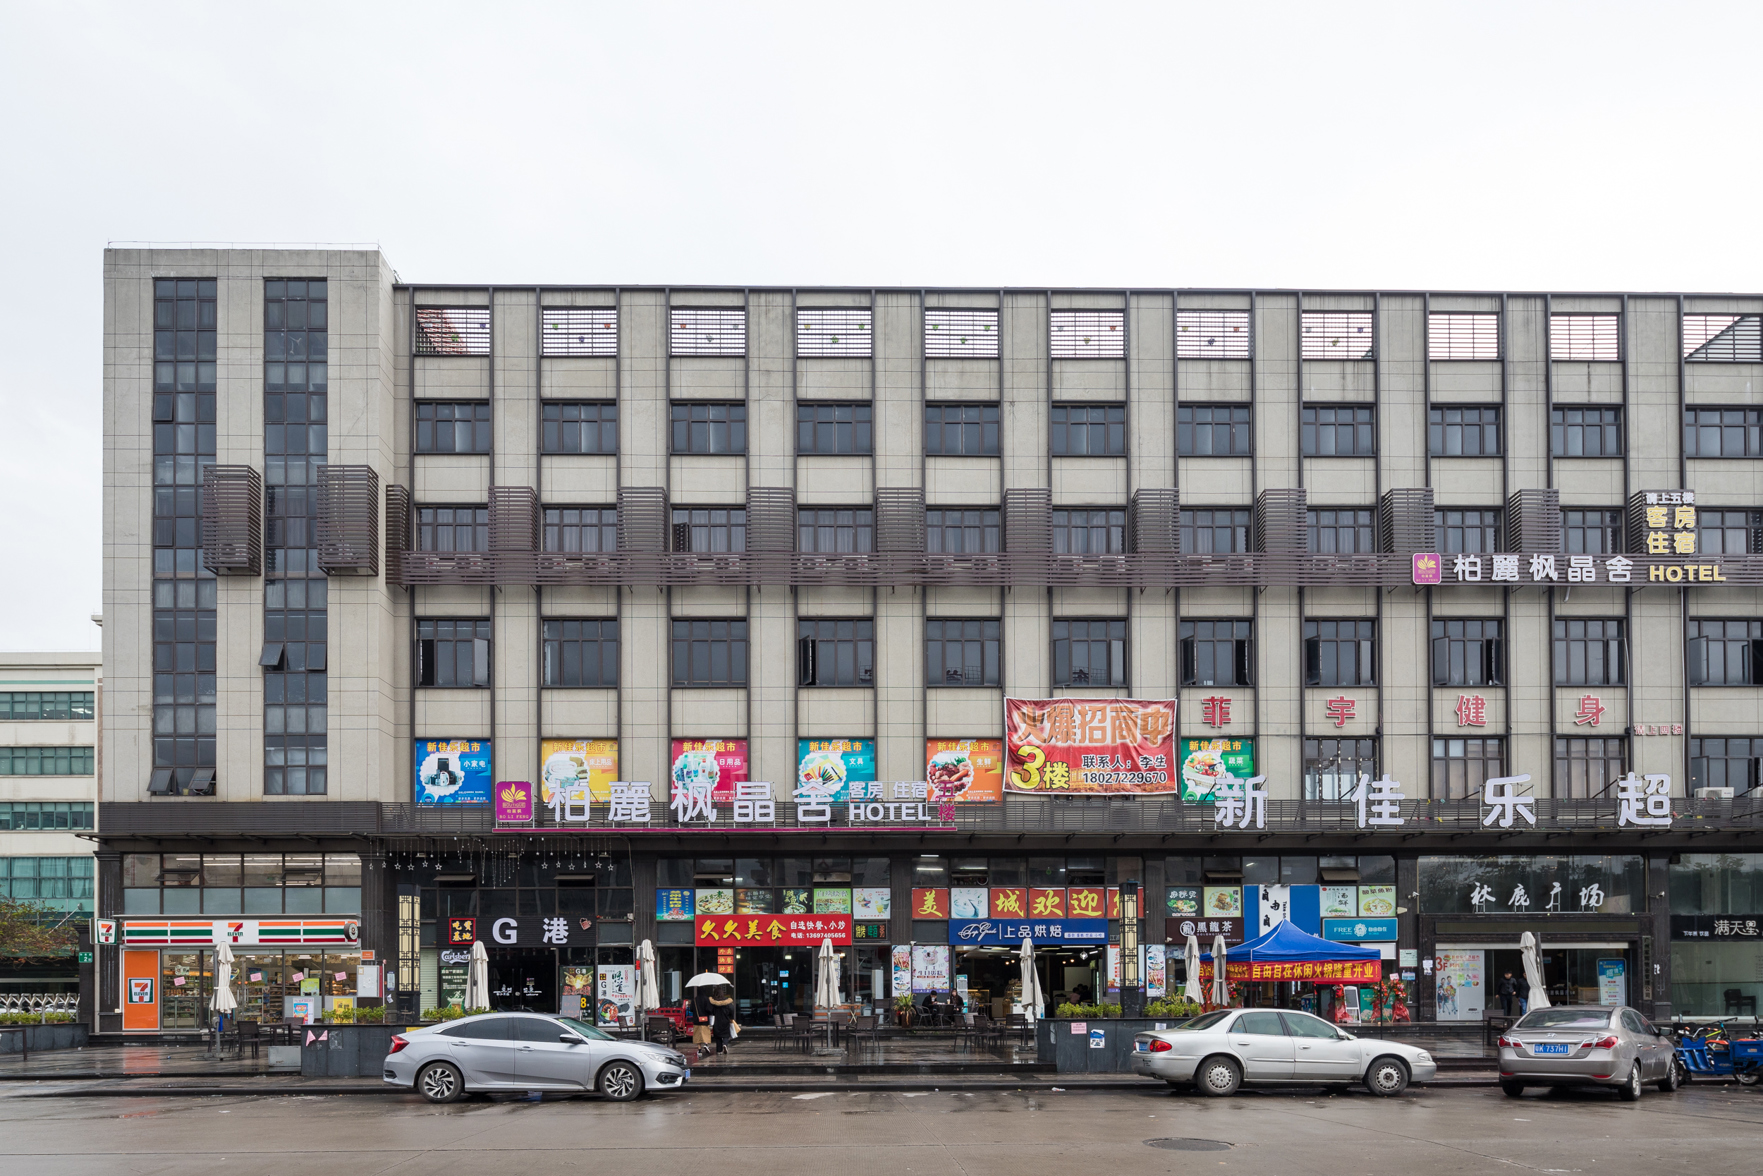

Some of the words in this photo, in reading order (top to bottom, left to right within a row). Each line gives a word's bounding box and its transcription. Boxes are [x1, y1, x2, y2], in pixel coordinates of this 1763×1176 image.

[1647, 505, 1696, 528] 客房
[1647, 531, 1696, 554] 住宿
[1649, 565, 1726, 582] HOTEL
[1016, 704, 1170, 747] 火爆招商中
[426, 741, 481, 752] 新佳乐超市
[552, 741, 607, 752] 新佳乐超市
[682, 741, 736, 752] 新佳乐超市
[809, 741, 863, 752] 新佳乐超市
[936, 741, 990, 752] 新佳乐超市
[1188, 740, 1242, 751] 新佳乐超市
[463, 760, 486, 768] 小家电
[588, 758, 613, 766] 床上用品
[719, 758, 742, 766] 日用品
[848, 757, 864, 766] 文具
[976, 757, 992, 766] 生鲜
[1011, 744, 1071, 790] 3楼
[1083, 771, 1168, 784] 18027229670
[849, 781, 884, 799] 客房
[893, 781, 927, 799] 住宿
[937, 781, 956, 822] 五楼
[1214, 770, 1673, 829] 新佳乐超
[849, 802, 932, 821] HOTEL
[700, 919, 787, 941] 久久美食
[790, 920, 846, 930] 自选快餐、小炒
[1004, 925, 1062, 938] 上品烘焙
[101, 924, 112, 942] 7
[228, 922, 243, 942] 7
[441, 950, 470, 963] Carlsber
[134, 983, 148, 1002] 7
